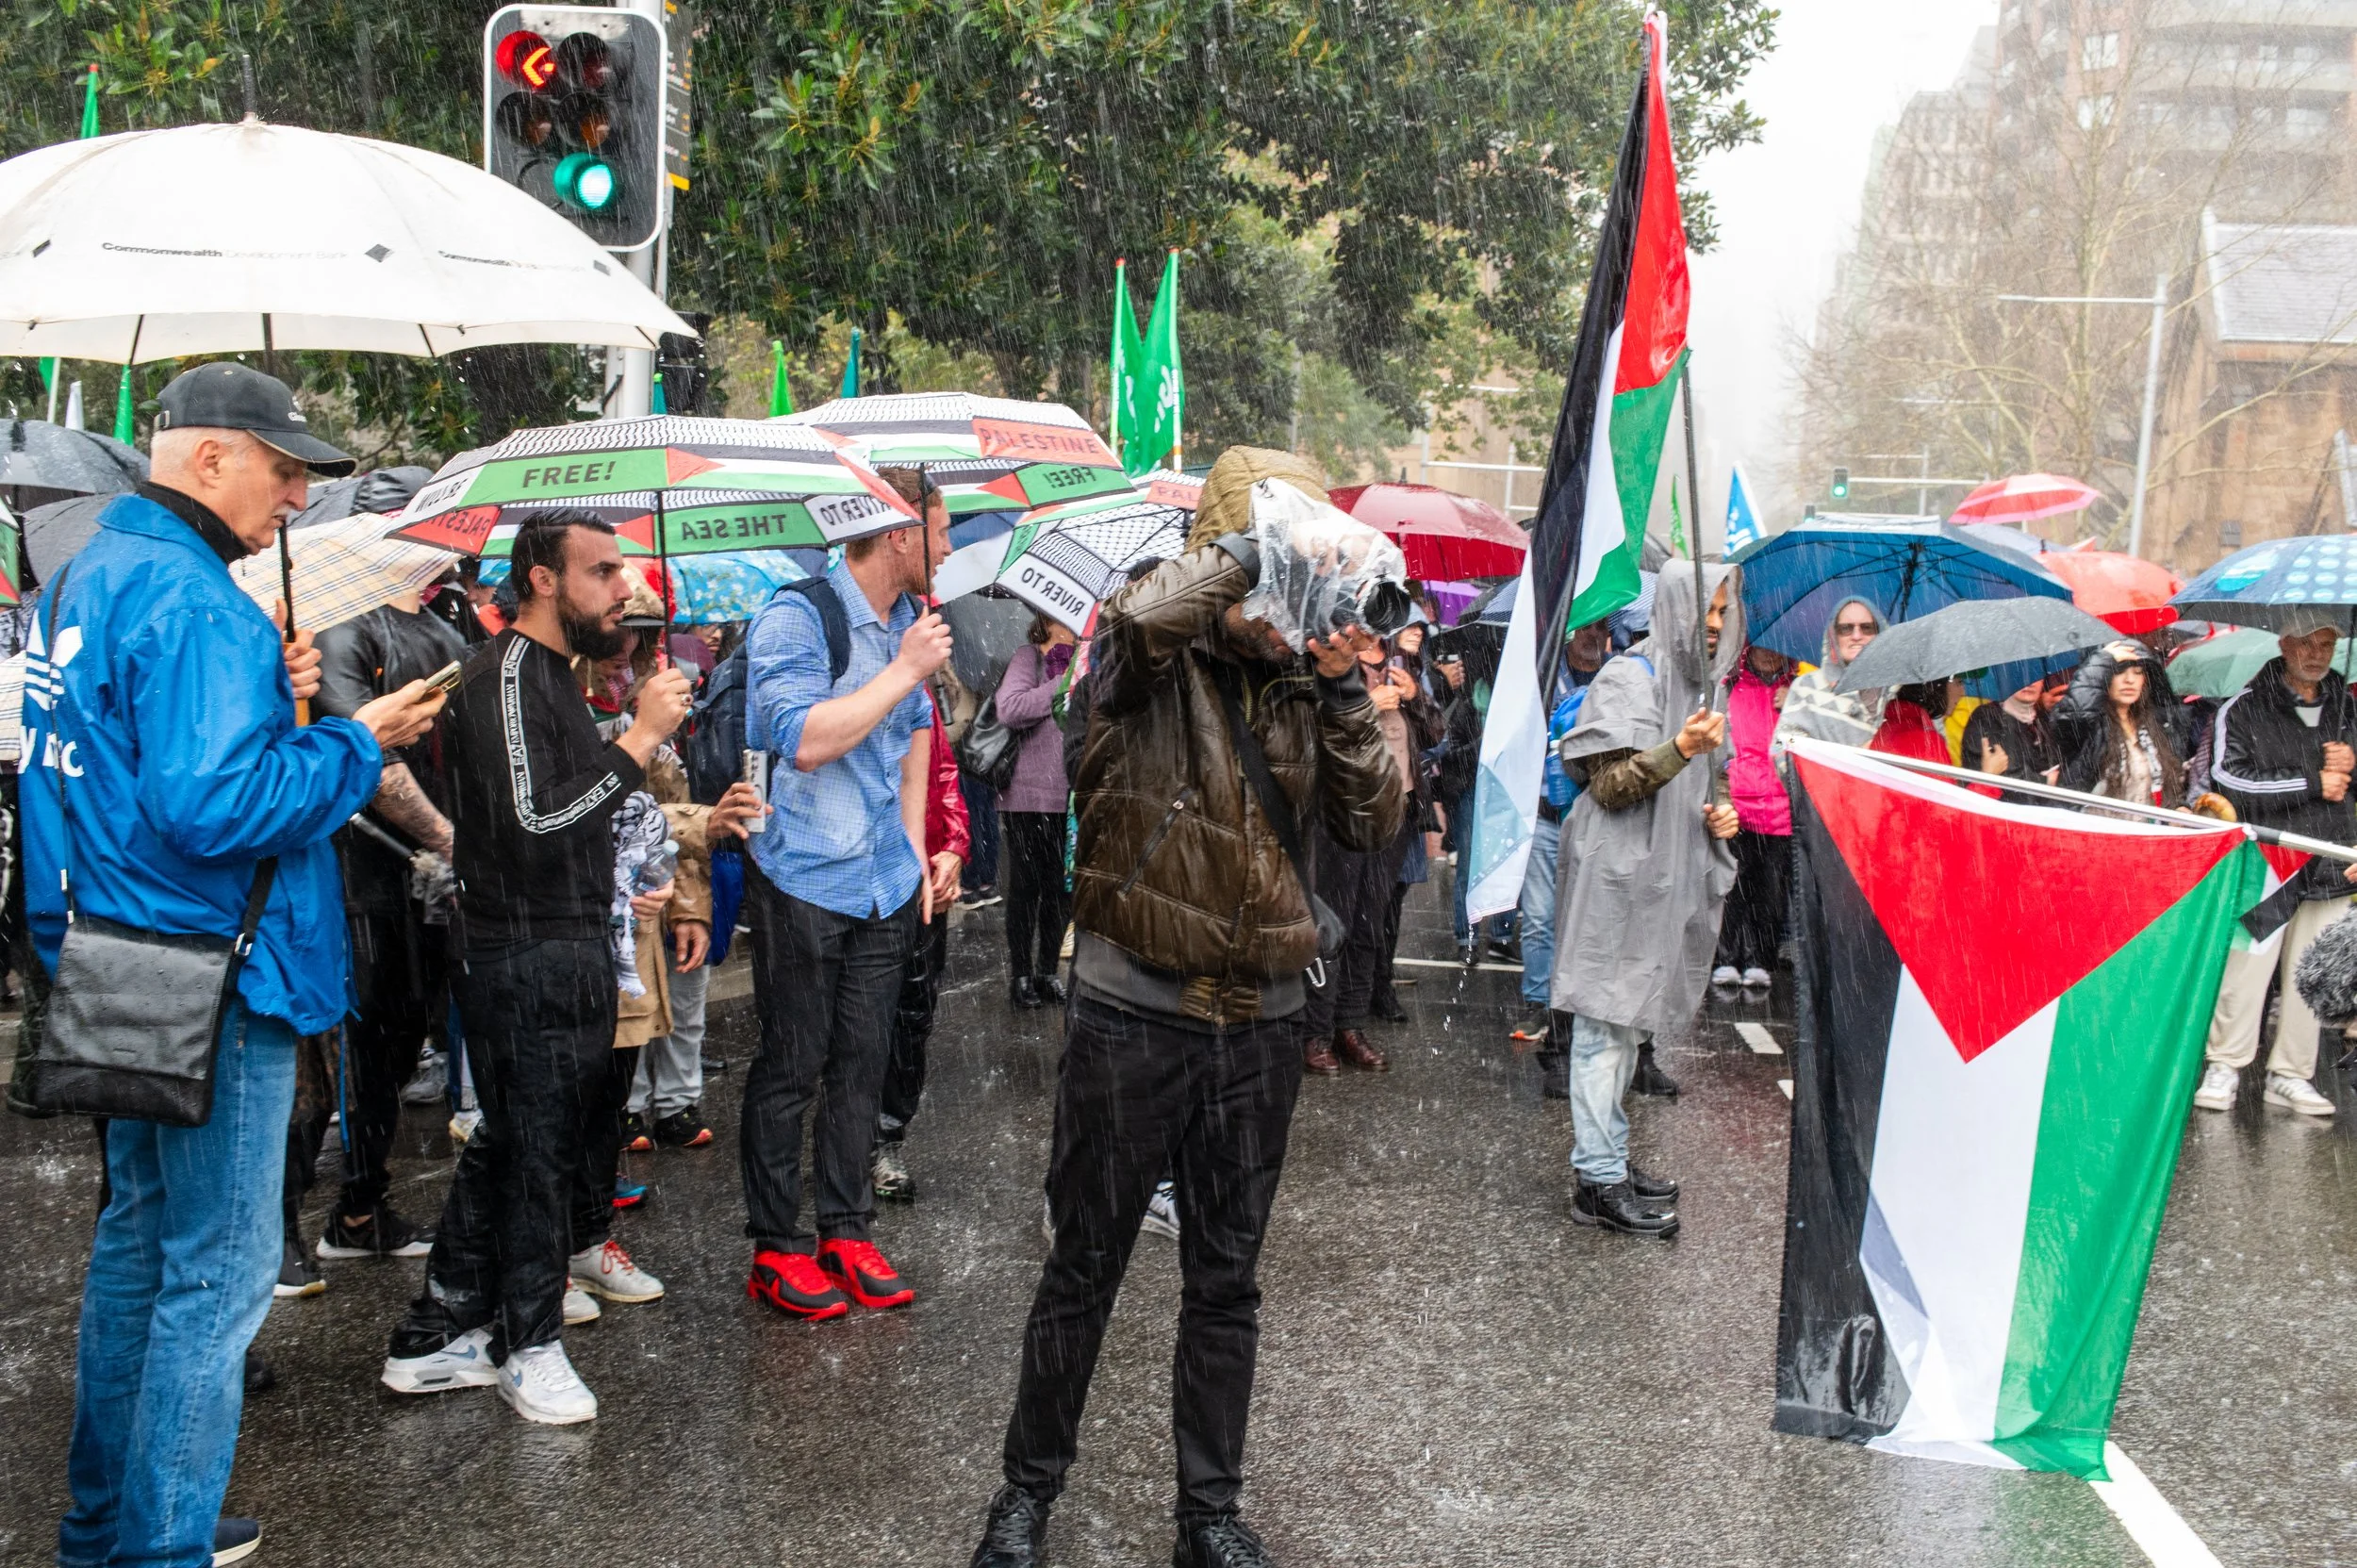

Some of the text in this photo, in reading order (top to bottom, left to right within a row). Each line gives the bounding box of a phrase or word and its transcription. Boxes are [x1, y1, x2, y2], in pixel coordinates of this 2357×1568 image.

[102, 241, 223, 257] Commonwealth
[979, 427, 1099, 454] PALESTINE
[522, 460, 618, 488] FREE!
